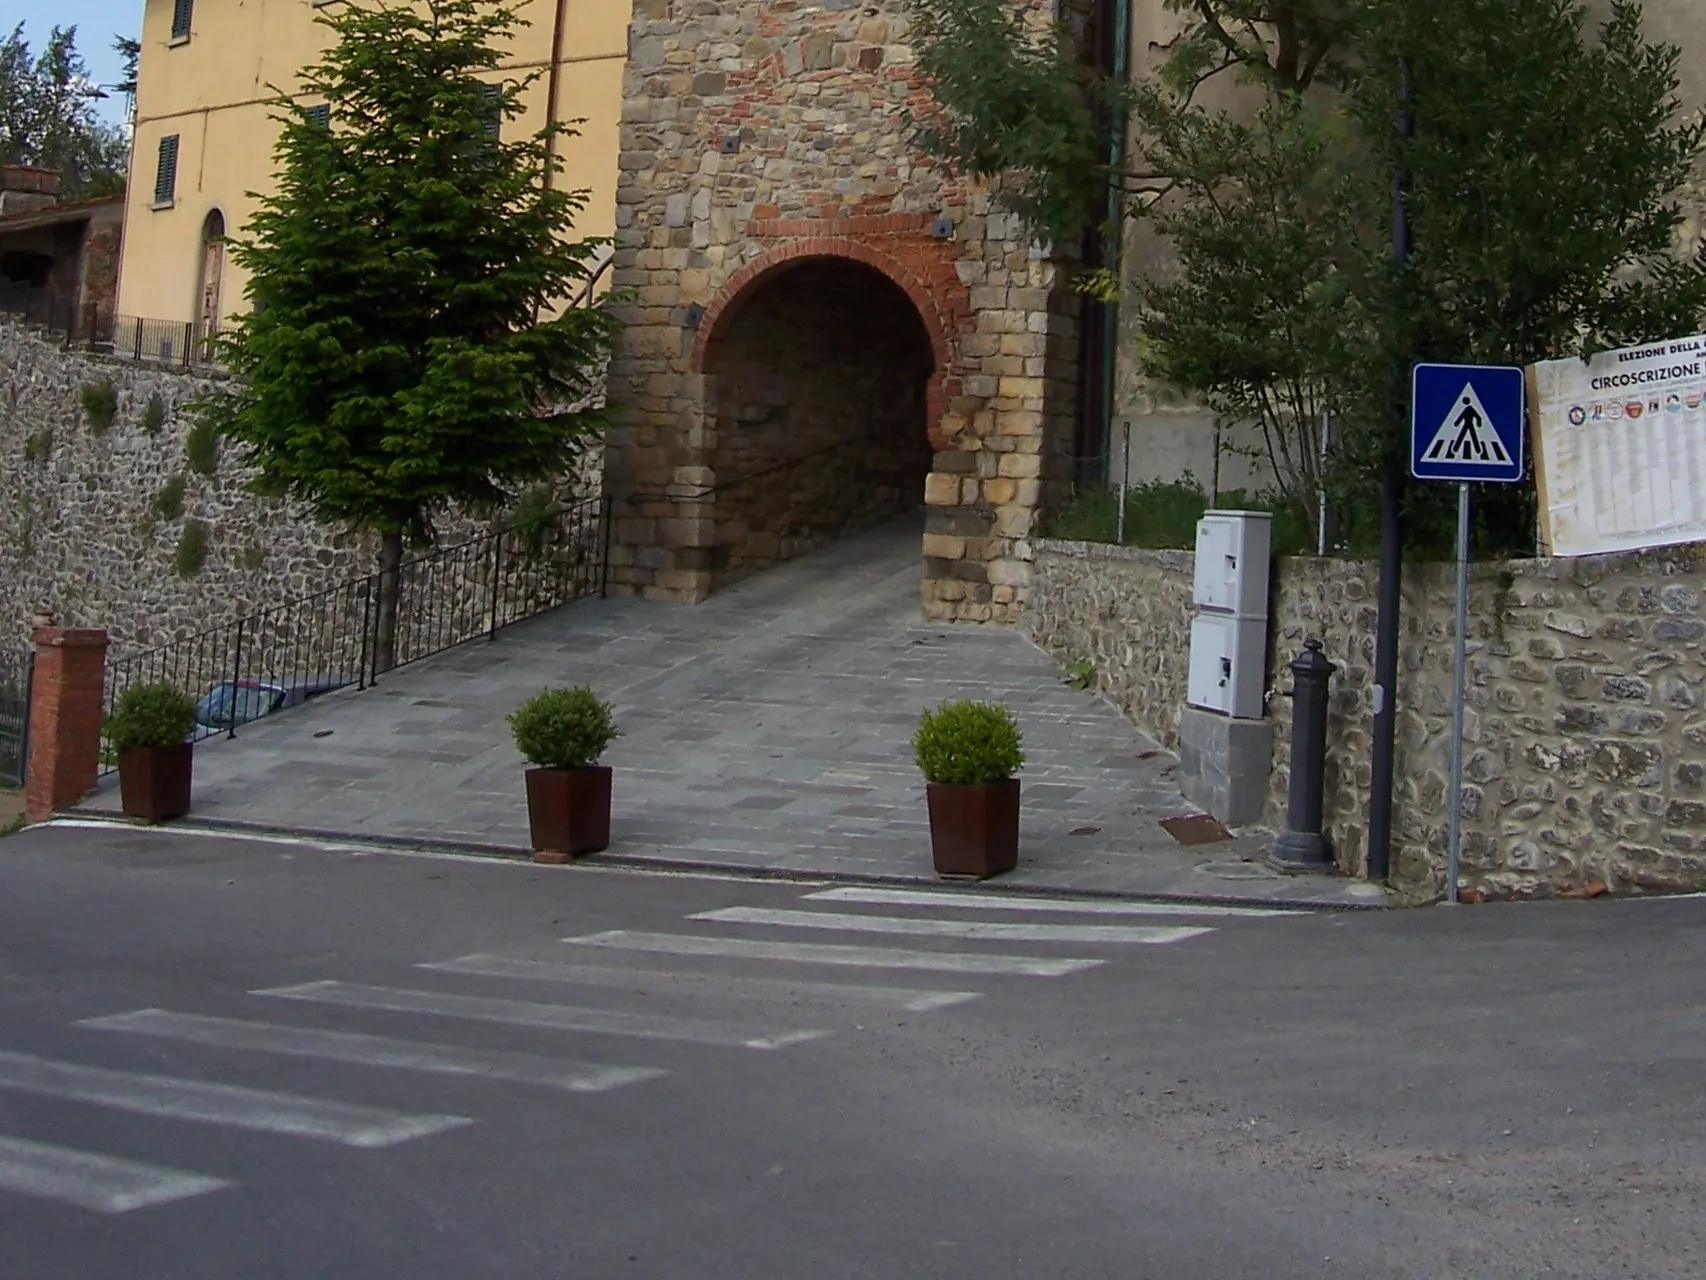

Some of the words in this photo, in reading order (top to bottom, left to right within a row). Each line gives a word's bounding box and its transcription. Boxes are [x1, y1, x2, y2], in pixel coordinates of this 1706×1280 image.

[1618, 347, 1666, 362] ELEZIONE
[1669, 342, 1701, 354] DELLA
[1591, 362, 1701, 390] CIRCOSCRIZIONE
